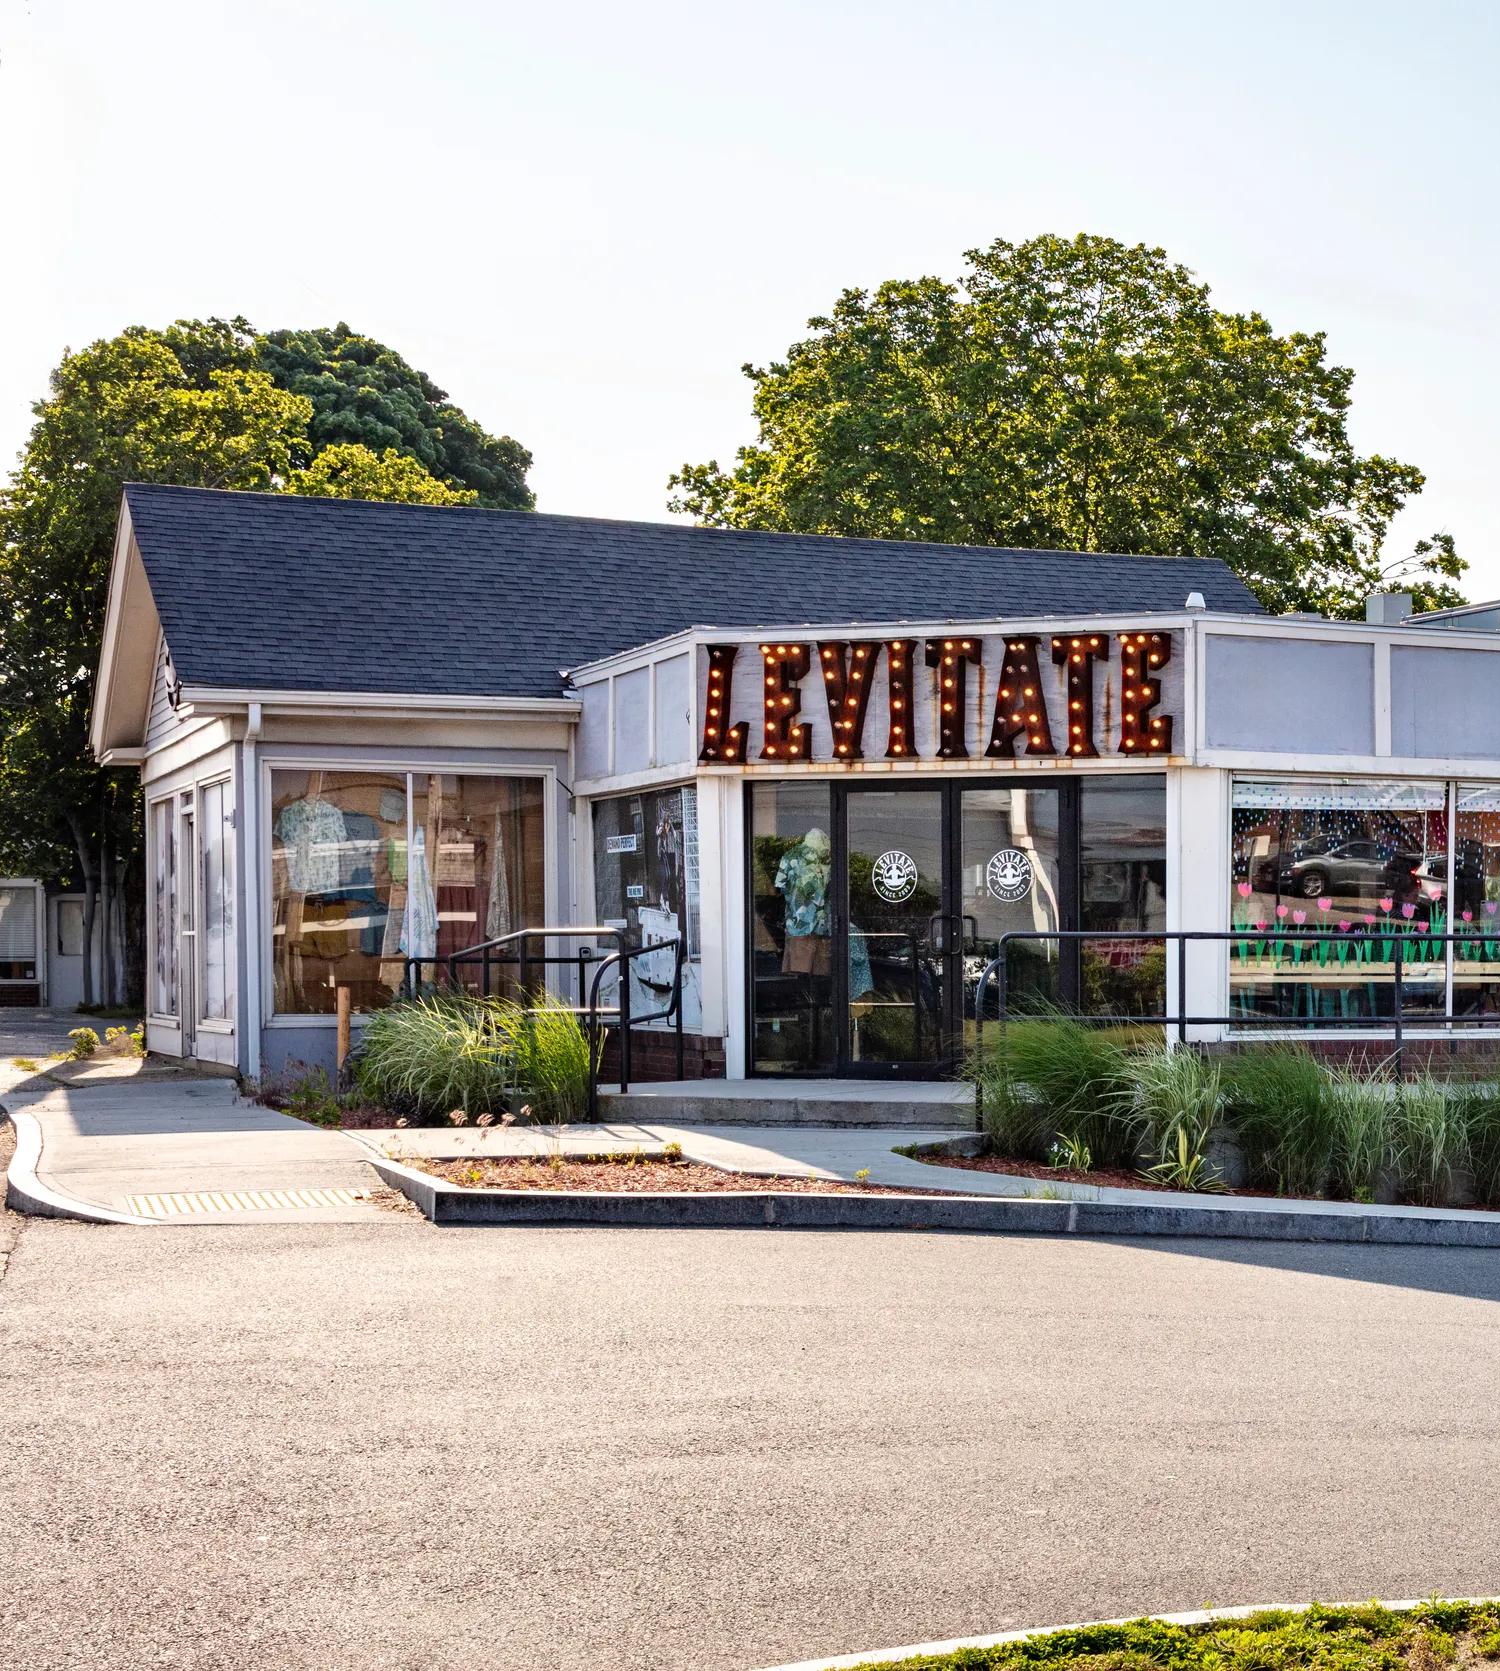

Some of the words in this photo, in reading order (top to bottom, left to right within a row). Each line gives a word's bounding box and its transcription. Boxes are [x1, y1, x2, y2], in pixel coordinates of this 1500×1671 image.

[698, 632, 1173, 764] LEVITATE
[875, 853, 915, 874] LEVITATE
[990, 852, 1030, 873] LEVITATE
